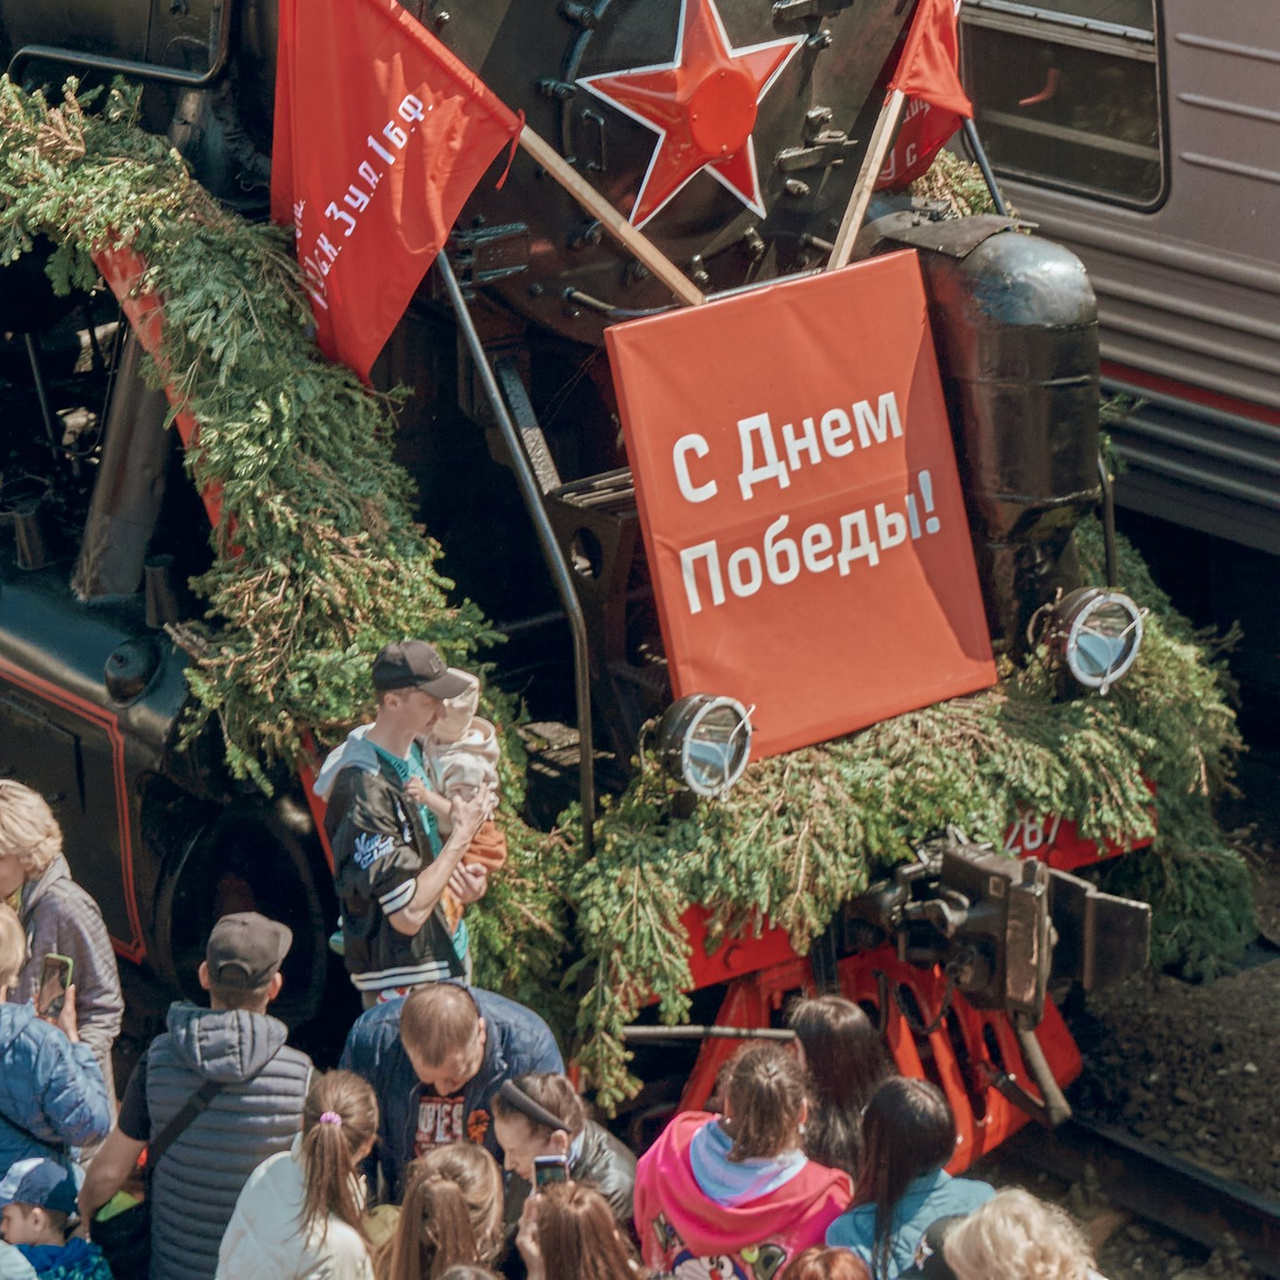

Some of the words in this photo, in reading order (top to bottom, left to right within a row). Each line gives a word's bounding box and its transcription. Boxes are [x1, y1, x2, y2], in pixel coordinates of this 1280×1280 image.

[672, 432, 718, 503] С
[737, 391, 903, 501] Днем
[679, 470, 941, 614] Победы!
